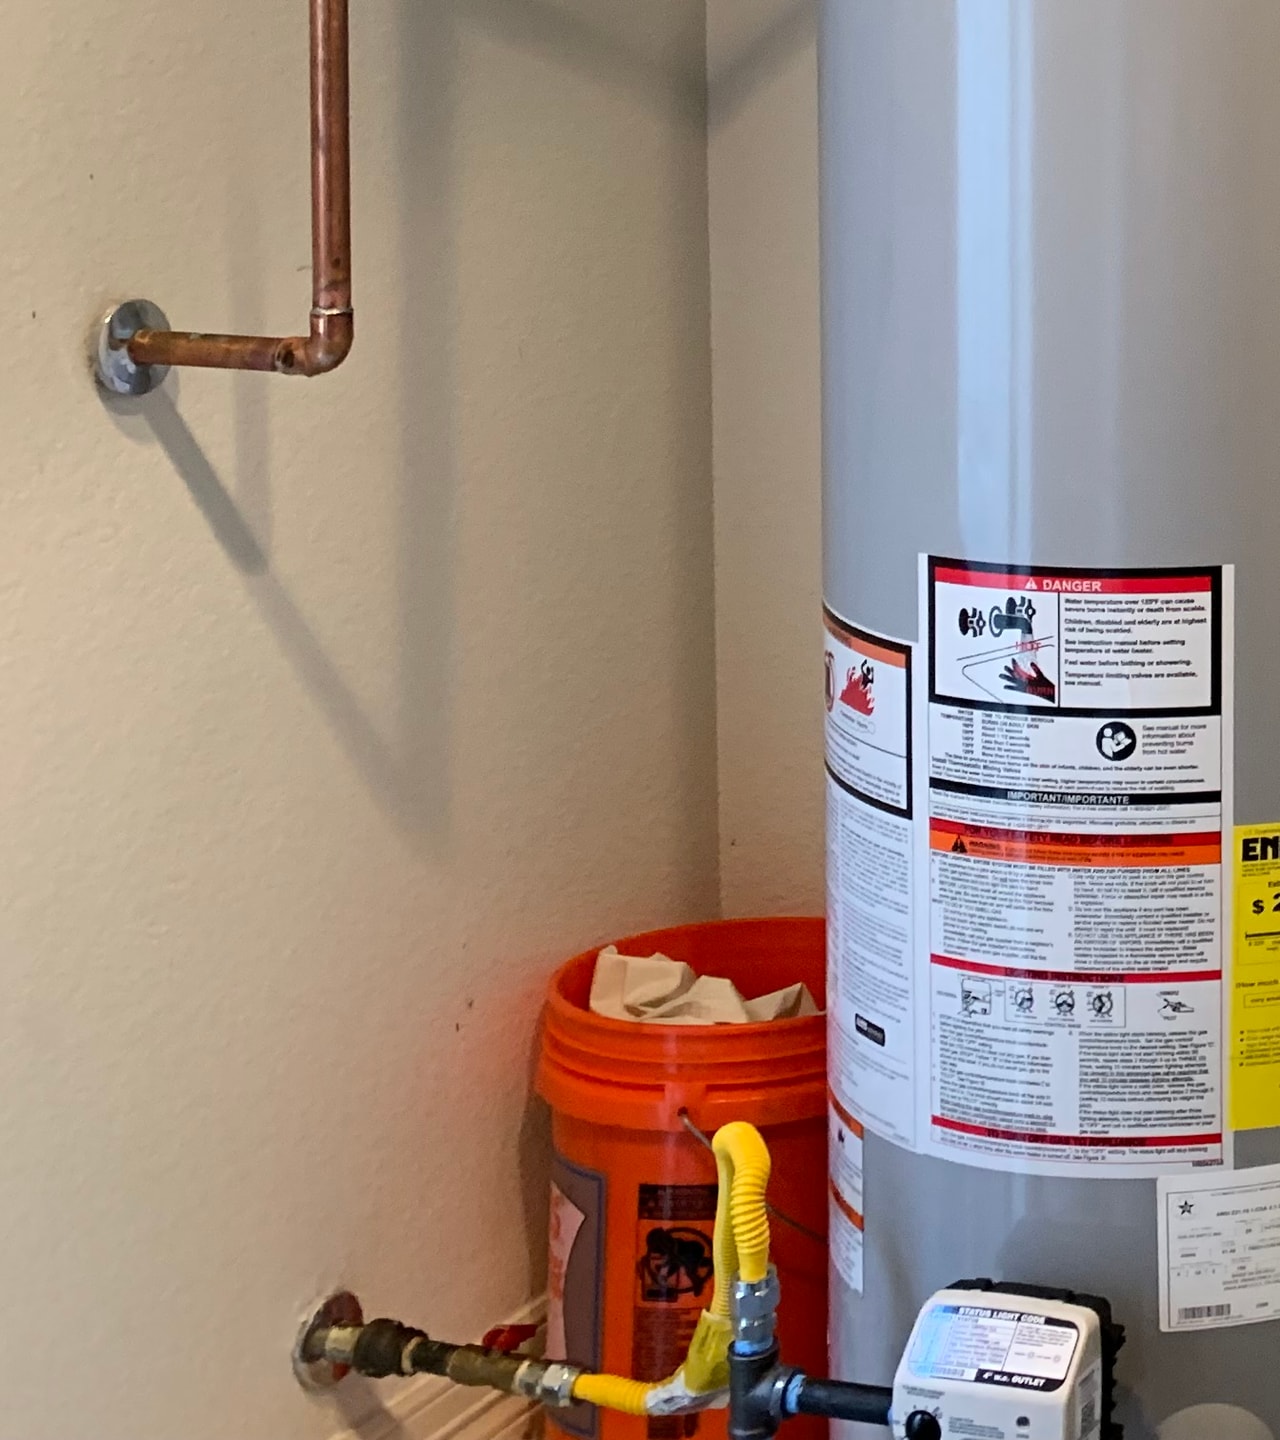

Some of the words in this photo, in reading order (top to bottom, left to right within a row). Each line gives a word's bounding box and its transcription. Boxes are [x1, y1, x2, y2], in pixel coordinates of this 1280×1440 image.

[1043, 580, 1102, 592] DANGER
[1007, 791, 1129, 805] IMPORTANT/IMPORTANTE
[1252, 899, 1265, 915] $
[959, 1307, 992, 1318] STATUS
[992, 1311, 1019, 1321] LIGHT
[1012, 1375, 1045, 1387] OUTLET
